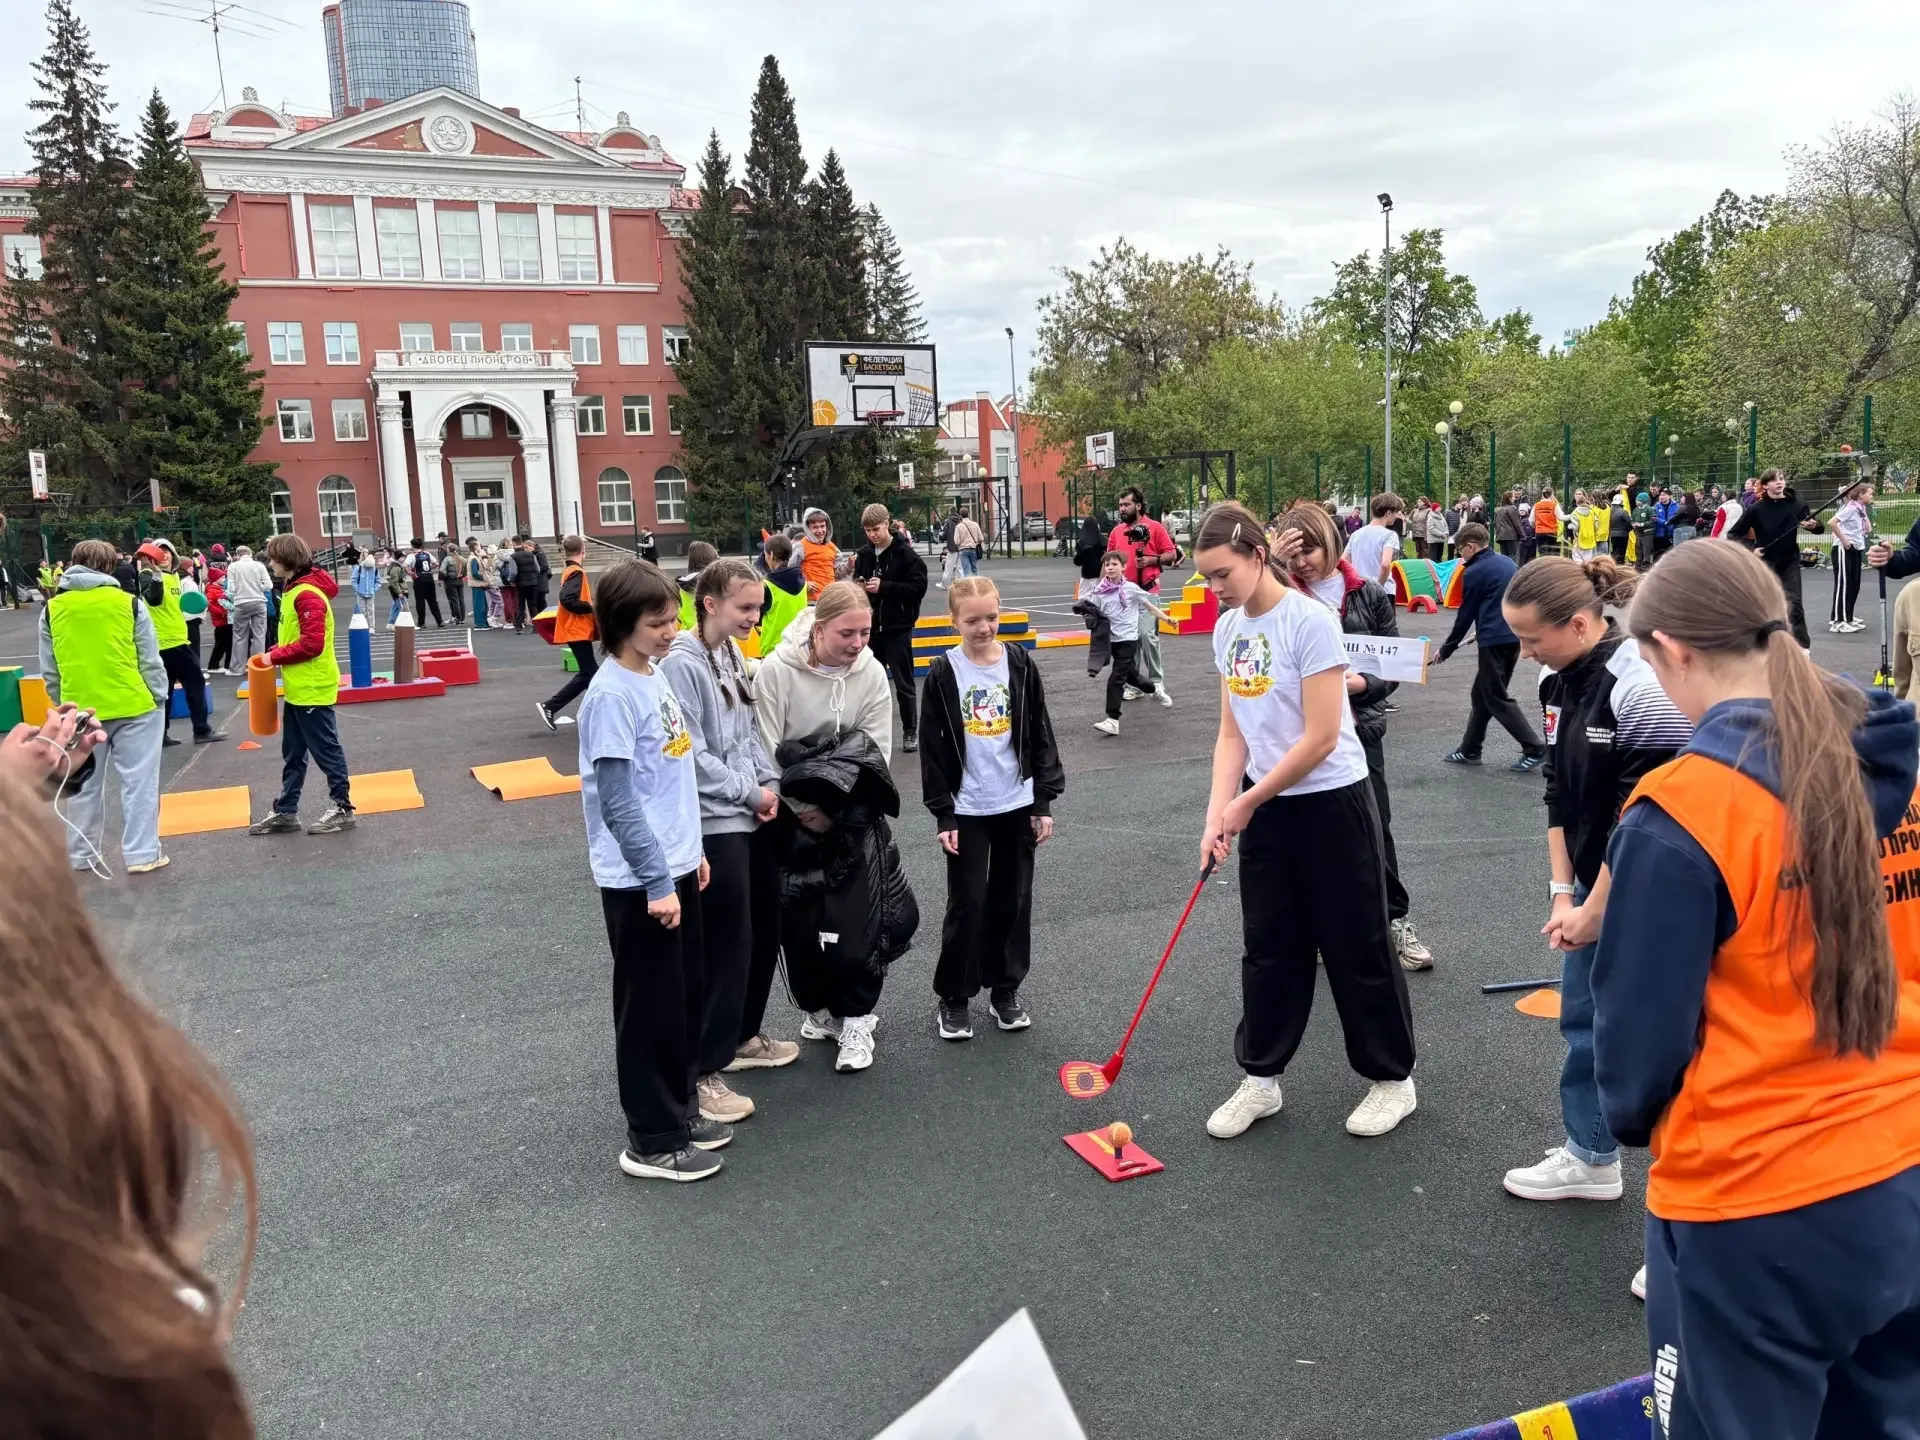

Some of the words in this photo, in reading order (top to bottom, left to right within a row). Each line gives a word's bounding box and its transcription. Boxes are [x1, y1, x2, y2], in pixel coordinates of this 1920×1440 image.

[421, 355, 468, 365] ДВОРЕЦ
[471, 355, 530, 365] ПИОНЕРОВ
[863, 356, 903, 364] ФЕДЕРАЦИЯ
[422, 560, 430, 571] 8
[1363, 644, 1376, 654] №
[1380, 645, 1399, 656] 147
[1888, 829, 1920, 857] ПРО
